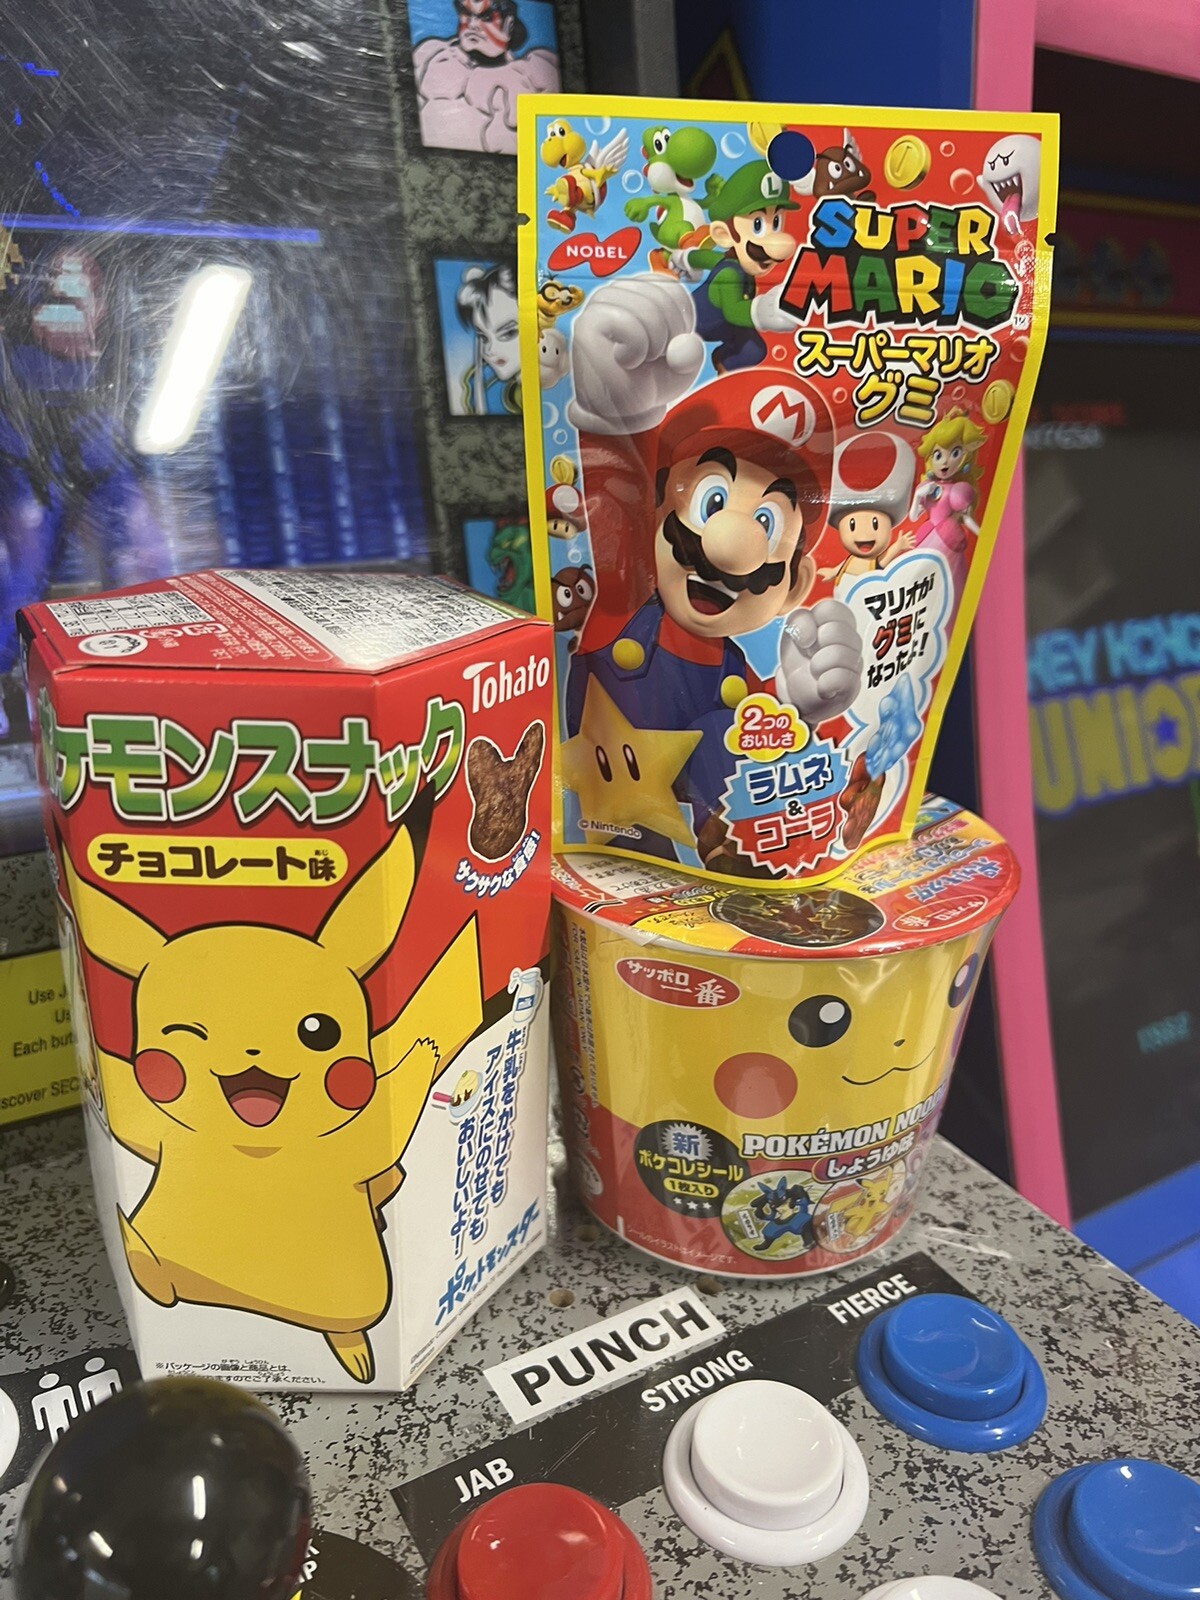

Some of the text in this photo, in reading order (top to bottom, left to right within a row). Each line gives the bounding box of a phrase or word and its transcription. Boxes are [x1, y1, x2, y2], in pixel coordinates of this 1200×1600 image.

[565, 244, 628, 259] NOBEL
[814, 202, 992, 255] SUPER
[784, 251, 1016, 320] MARIO
[800, 332, 996, 379] スーパーマリオ
[858, 370, 936, 426] グミ
[864, 570, 936, 621] マリオが
[873, 609, 925, 661] グミに
[463, 656, 550, 713] Tohato
[740, 731, 794, 749] おいしさ
[741, 707, 789, 732] 2つの
[746, 755, 833, 804] ラムネ
[755, 808, 839, 850] コーラ
[787, 800, 803, 817] &
[97, 842, 337, 882] チョコレート味
[13, 1037, 47, 1057] Each
[51, 1075, 80, 1096] SEC
[490, 1028, 522, 1203] 牛乳をかけても
[743, 1119, 890, 1157] POKÉMON
[468, 1045, 502, 1240] アイスにのせても
[639, 1149, 744, 1181] ポケコレシール
[672, 1132, 700, 1156] 新
[827, 1131, 915, 1178] しょうゆ味
[452, 1118, 474, 1256] おいしいよ!
[669, 1180, 714, 1196] 1枚入り
[435, 1197, 539, 1325] ポケットモンスター
[826, 1273, 918, 1325] FIERCE
[510, 1299, 711, 1407] PUNCH
[640, 1349, 753, 1412] STRONG
[455, 1458, 515, 1503] JAB
